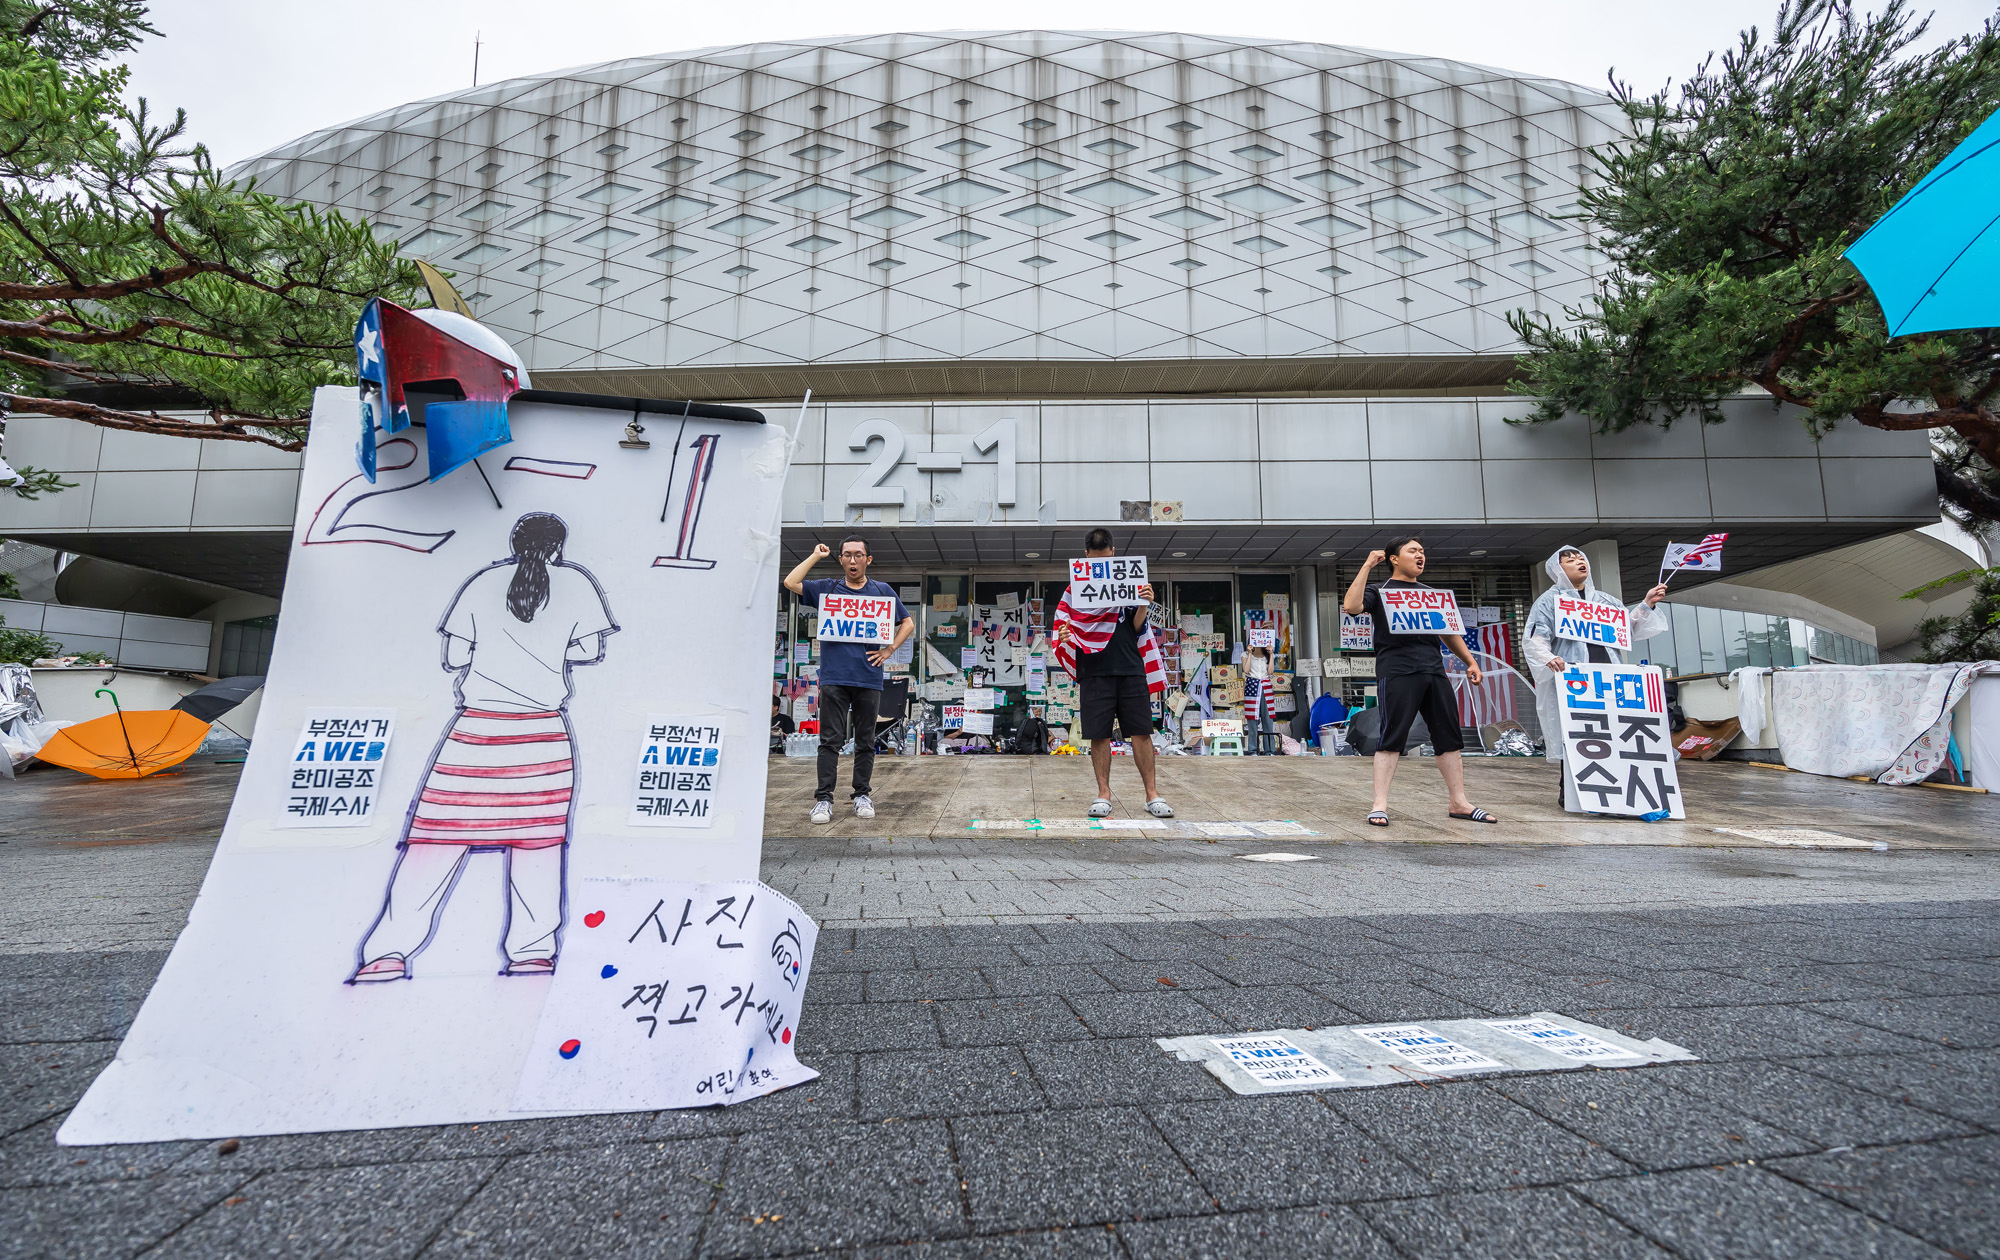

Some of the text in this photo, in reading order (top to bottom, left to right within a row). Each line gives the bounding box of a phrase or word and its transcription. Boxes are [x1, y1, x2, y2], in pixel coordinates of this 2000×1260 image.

[846, 418, 1016, 507] 2-1
[1072, 559, 1144, 581] 한미공조
[823, 597, 891, 619] 부정선거
[1385, 590, 1455, 609] 부정선거
[1559, 598, 1626, 627] 부정선거
[1563, 667, 1662, 713] 한미
[307, 719, 389, 738] 부정선거
[649, 724, 720, 744] 부정선거
[1568, 712, 1668, 762] 공조
[291, 768, 375, 789] 한미공조
[639, 770, 712, 791] 한미공조
[1575, 761, 1676, 813] 수사
[287, 796, 370, 817] 국제수사
[637, 797, 709, 817] 국제수사
[628, 894, 755, 949] 사진
